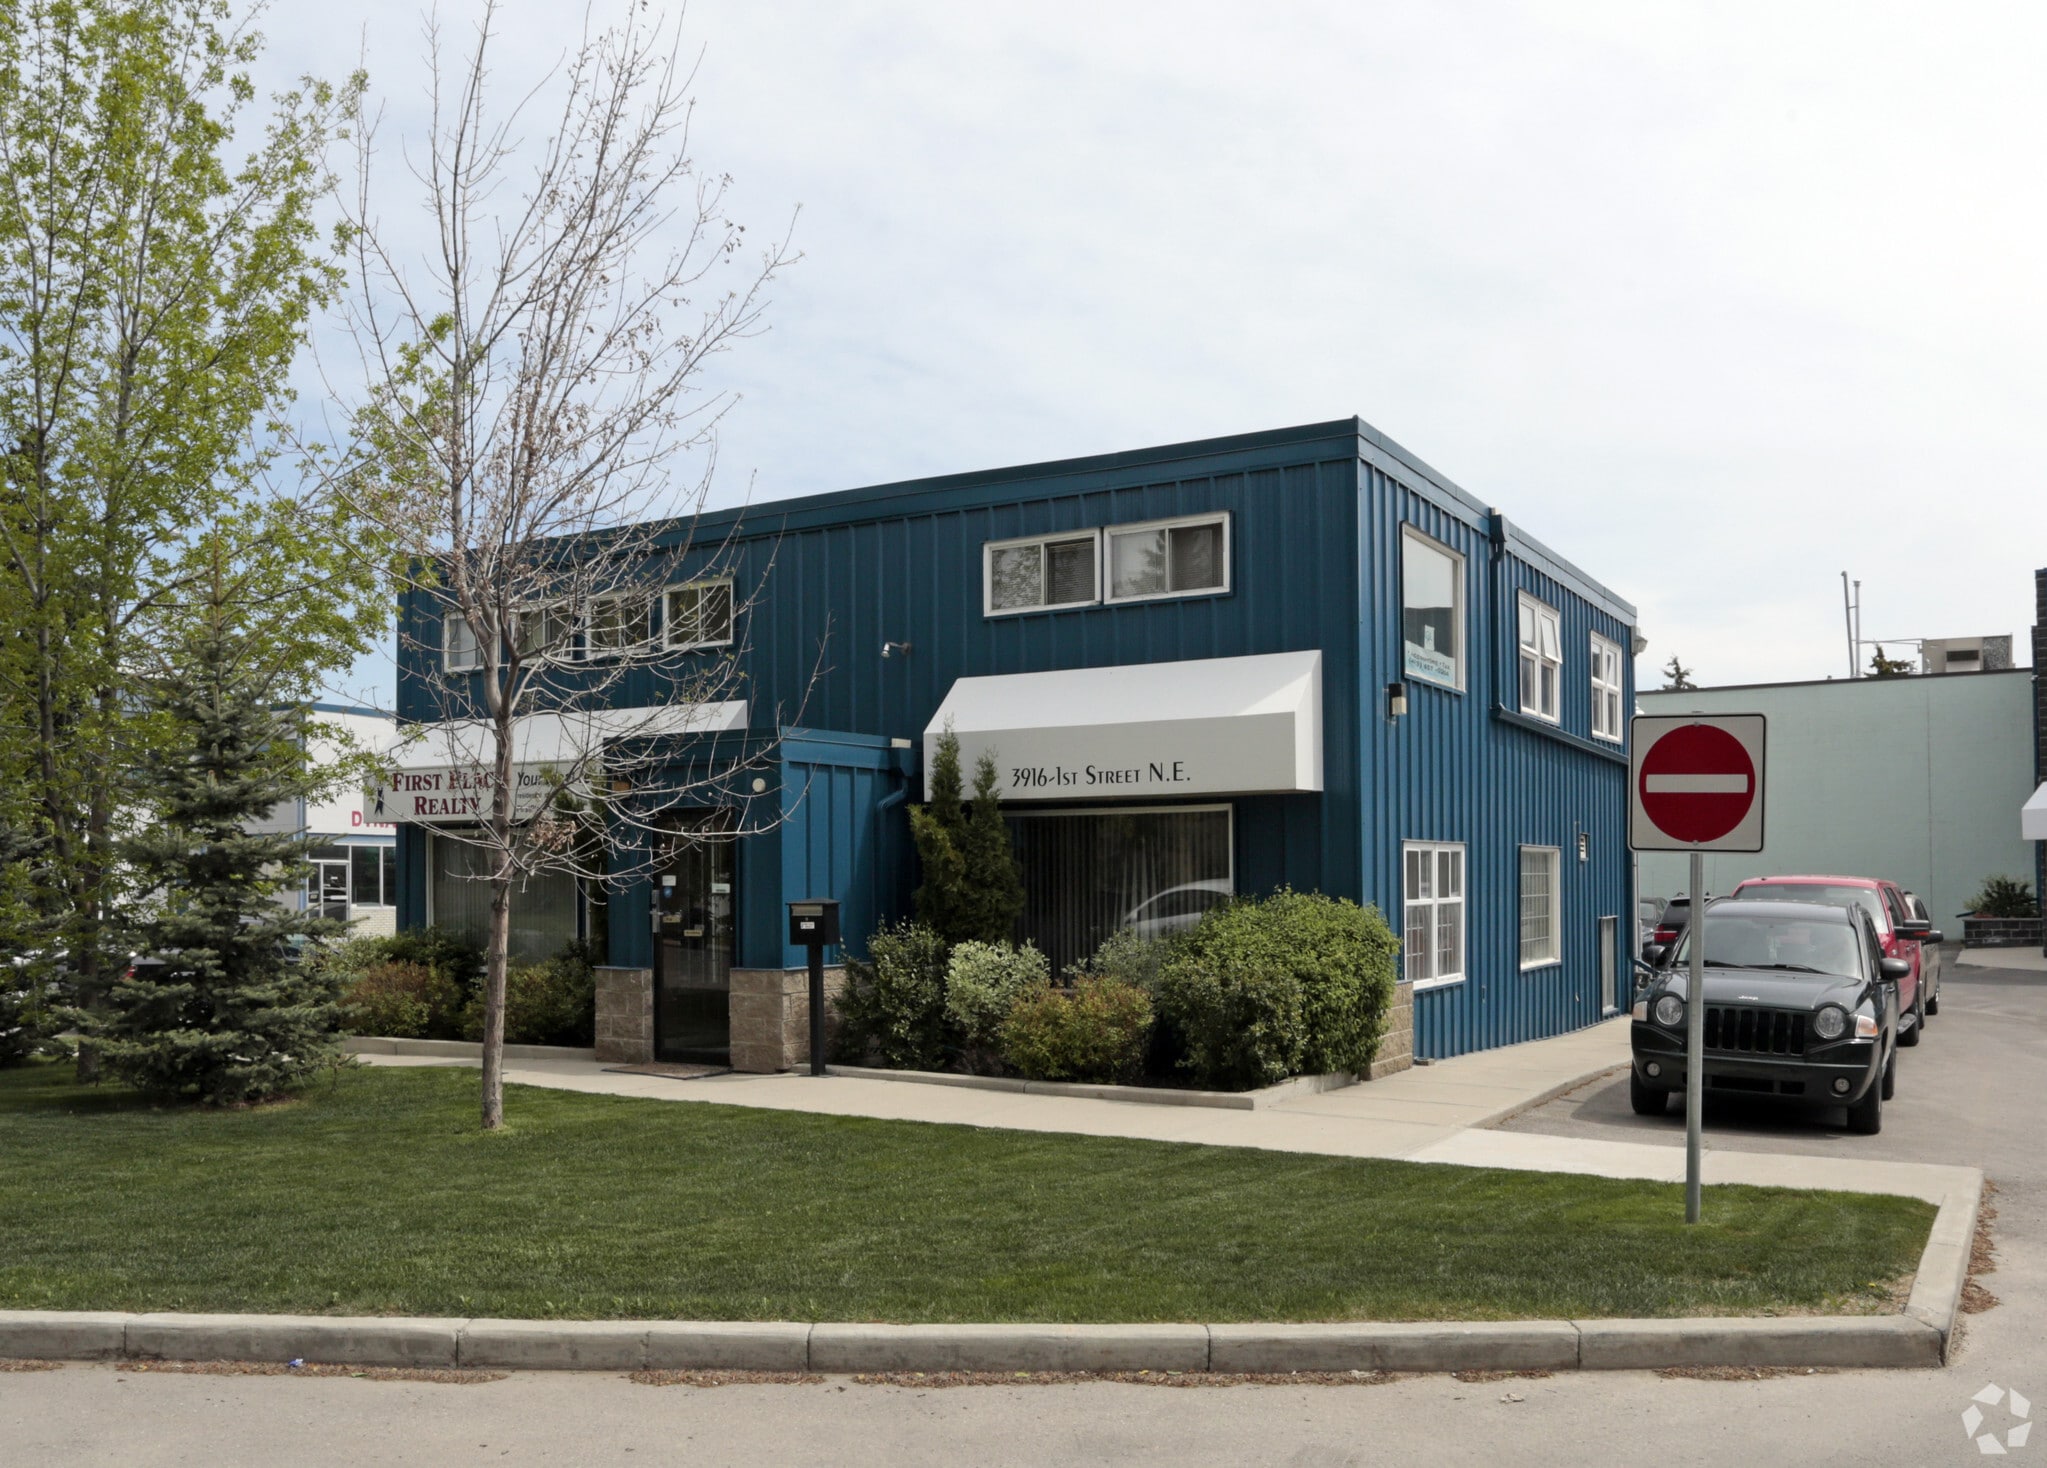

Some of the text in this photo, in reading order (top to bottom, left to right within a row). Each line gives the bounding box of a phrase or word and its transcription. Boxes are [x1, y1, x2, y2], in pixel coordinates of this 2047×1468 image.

[392, 771, 495, 792] FIRST PLAC
[1086, 765, 1140, 785] STREET
[1150, 761, 1190, 782] N.E.
[414, 795, 481, 815] REALTY
